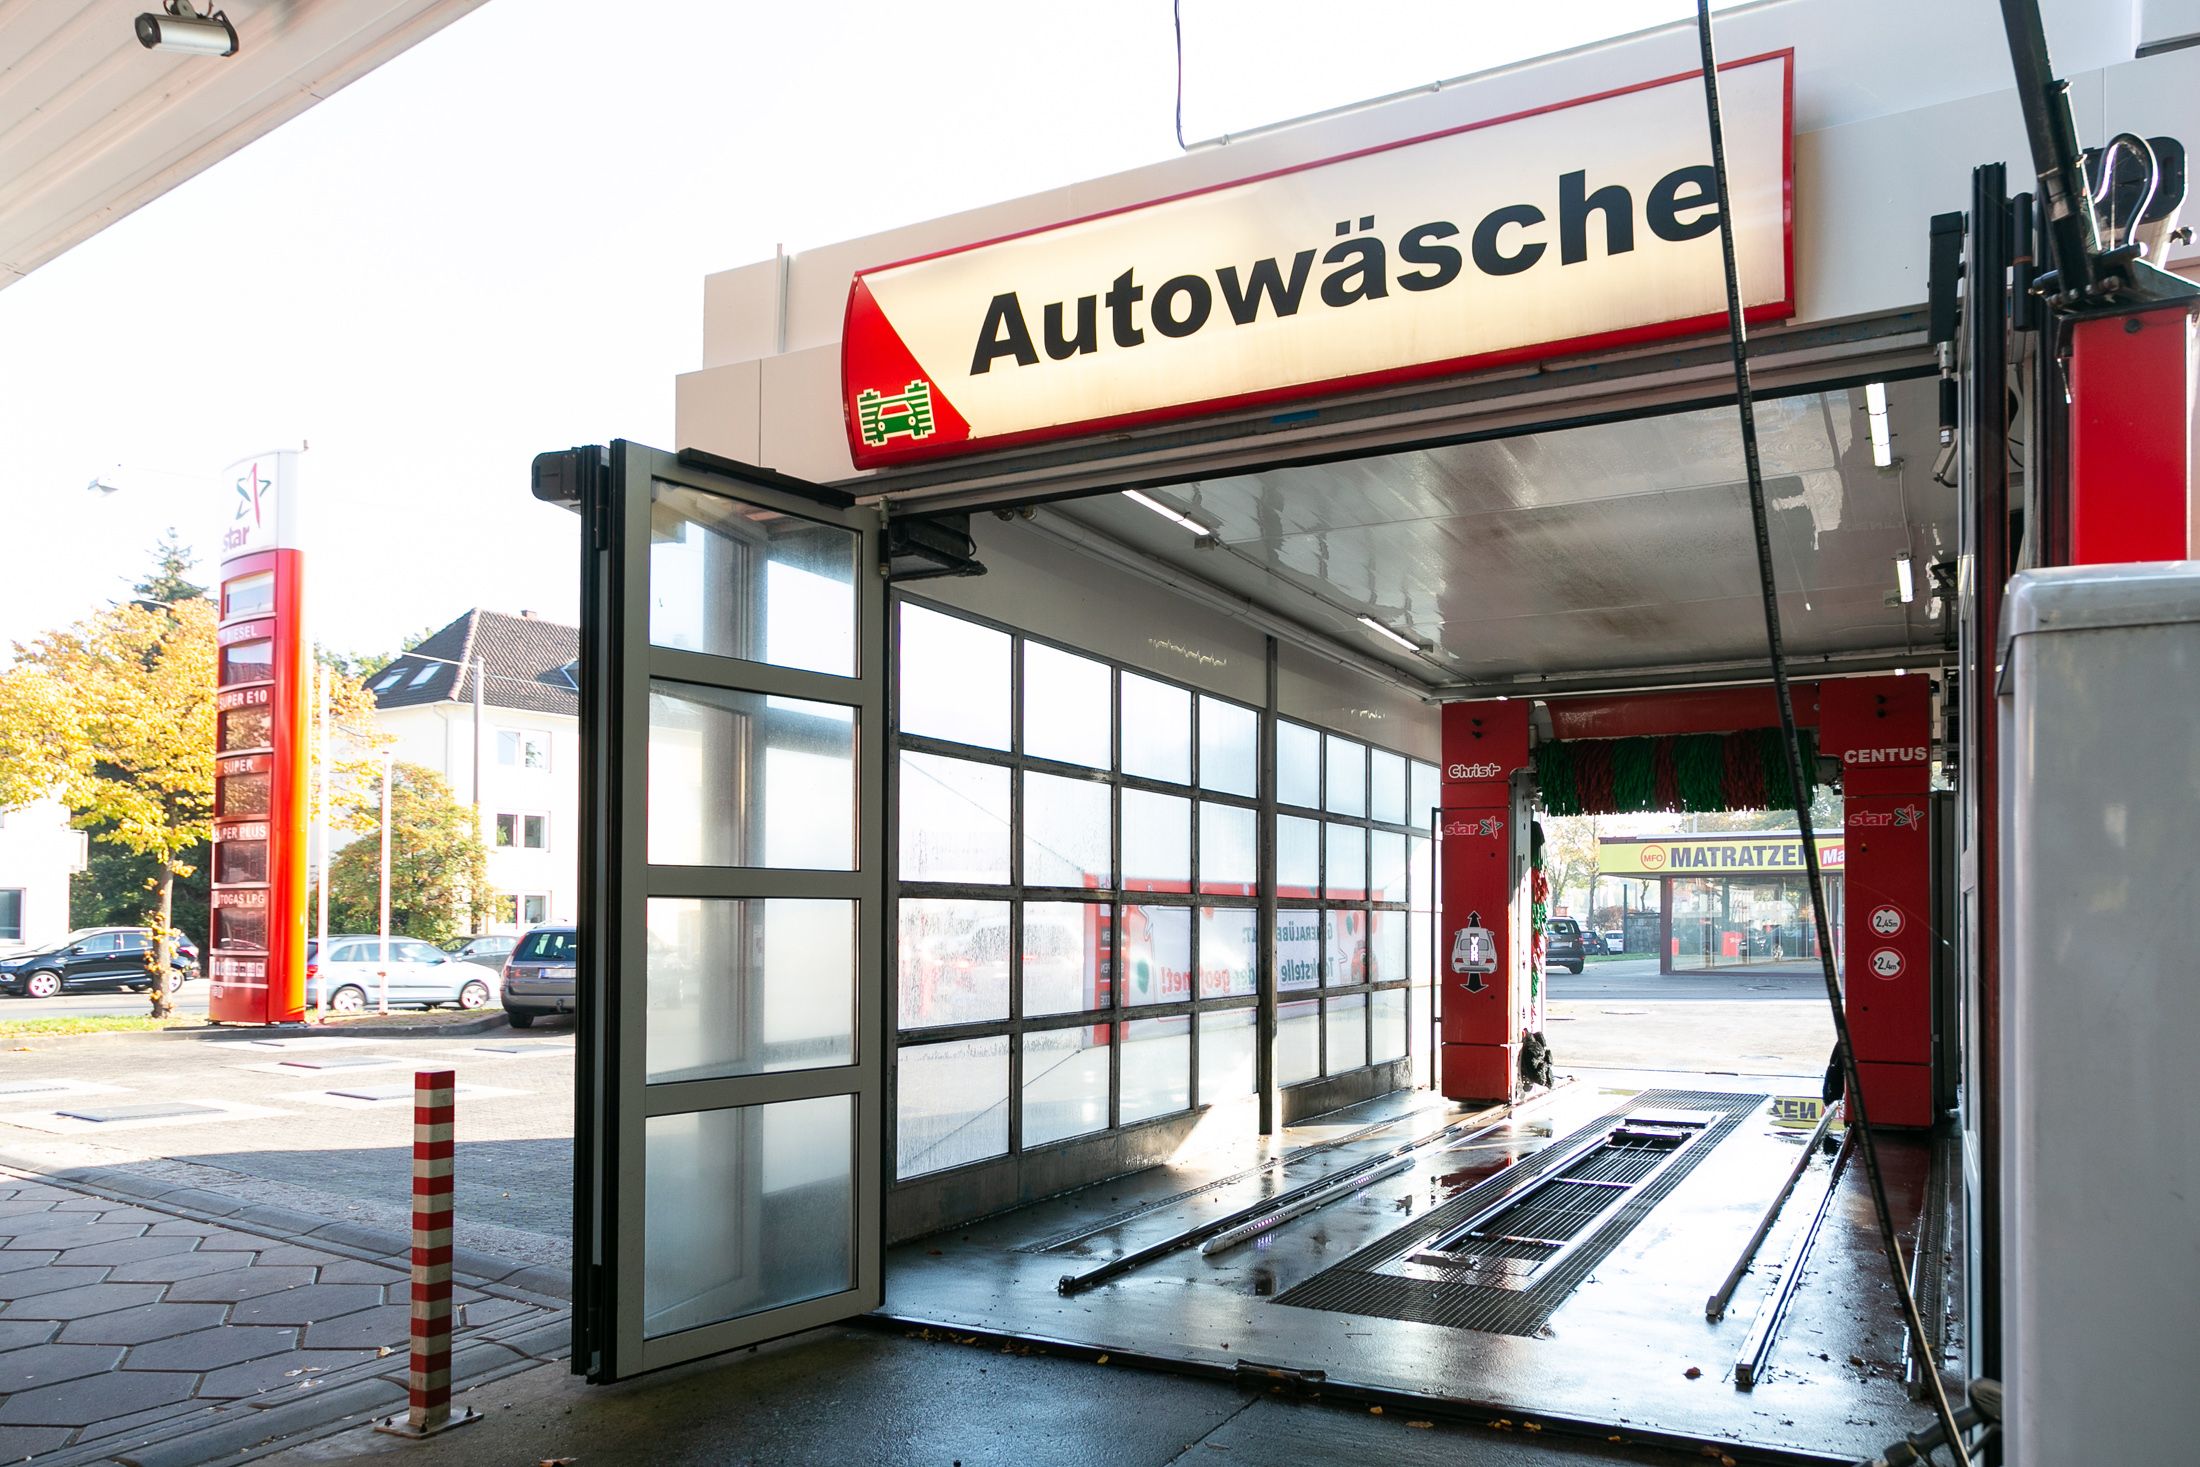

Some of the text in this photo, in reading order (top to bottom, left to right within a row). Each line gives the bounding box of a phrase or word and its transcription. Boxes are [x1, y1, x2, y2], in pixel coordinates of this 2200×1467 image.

[971, 164, 1721, 376] Autowäsche
[225, 624, 257, 643] DIESEL
[219, 689, 268, 709] SUPER E10
[1844, 747, 1928, 764] CENTUS
[224, 759, 253, 774] SUPER
[1448, 762, 1501, 779] Christ
[1848, 811, 1892, 827] star
[239, 825, 267, 839] PLUS
[1444, 821, 1478, 836] star
[1643, 854, 1663, 862] MFO
[246, 893, 265, 905] LPG
